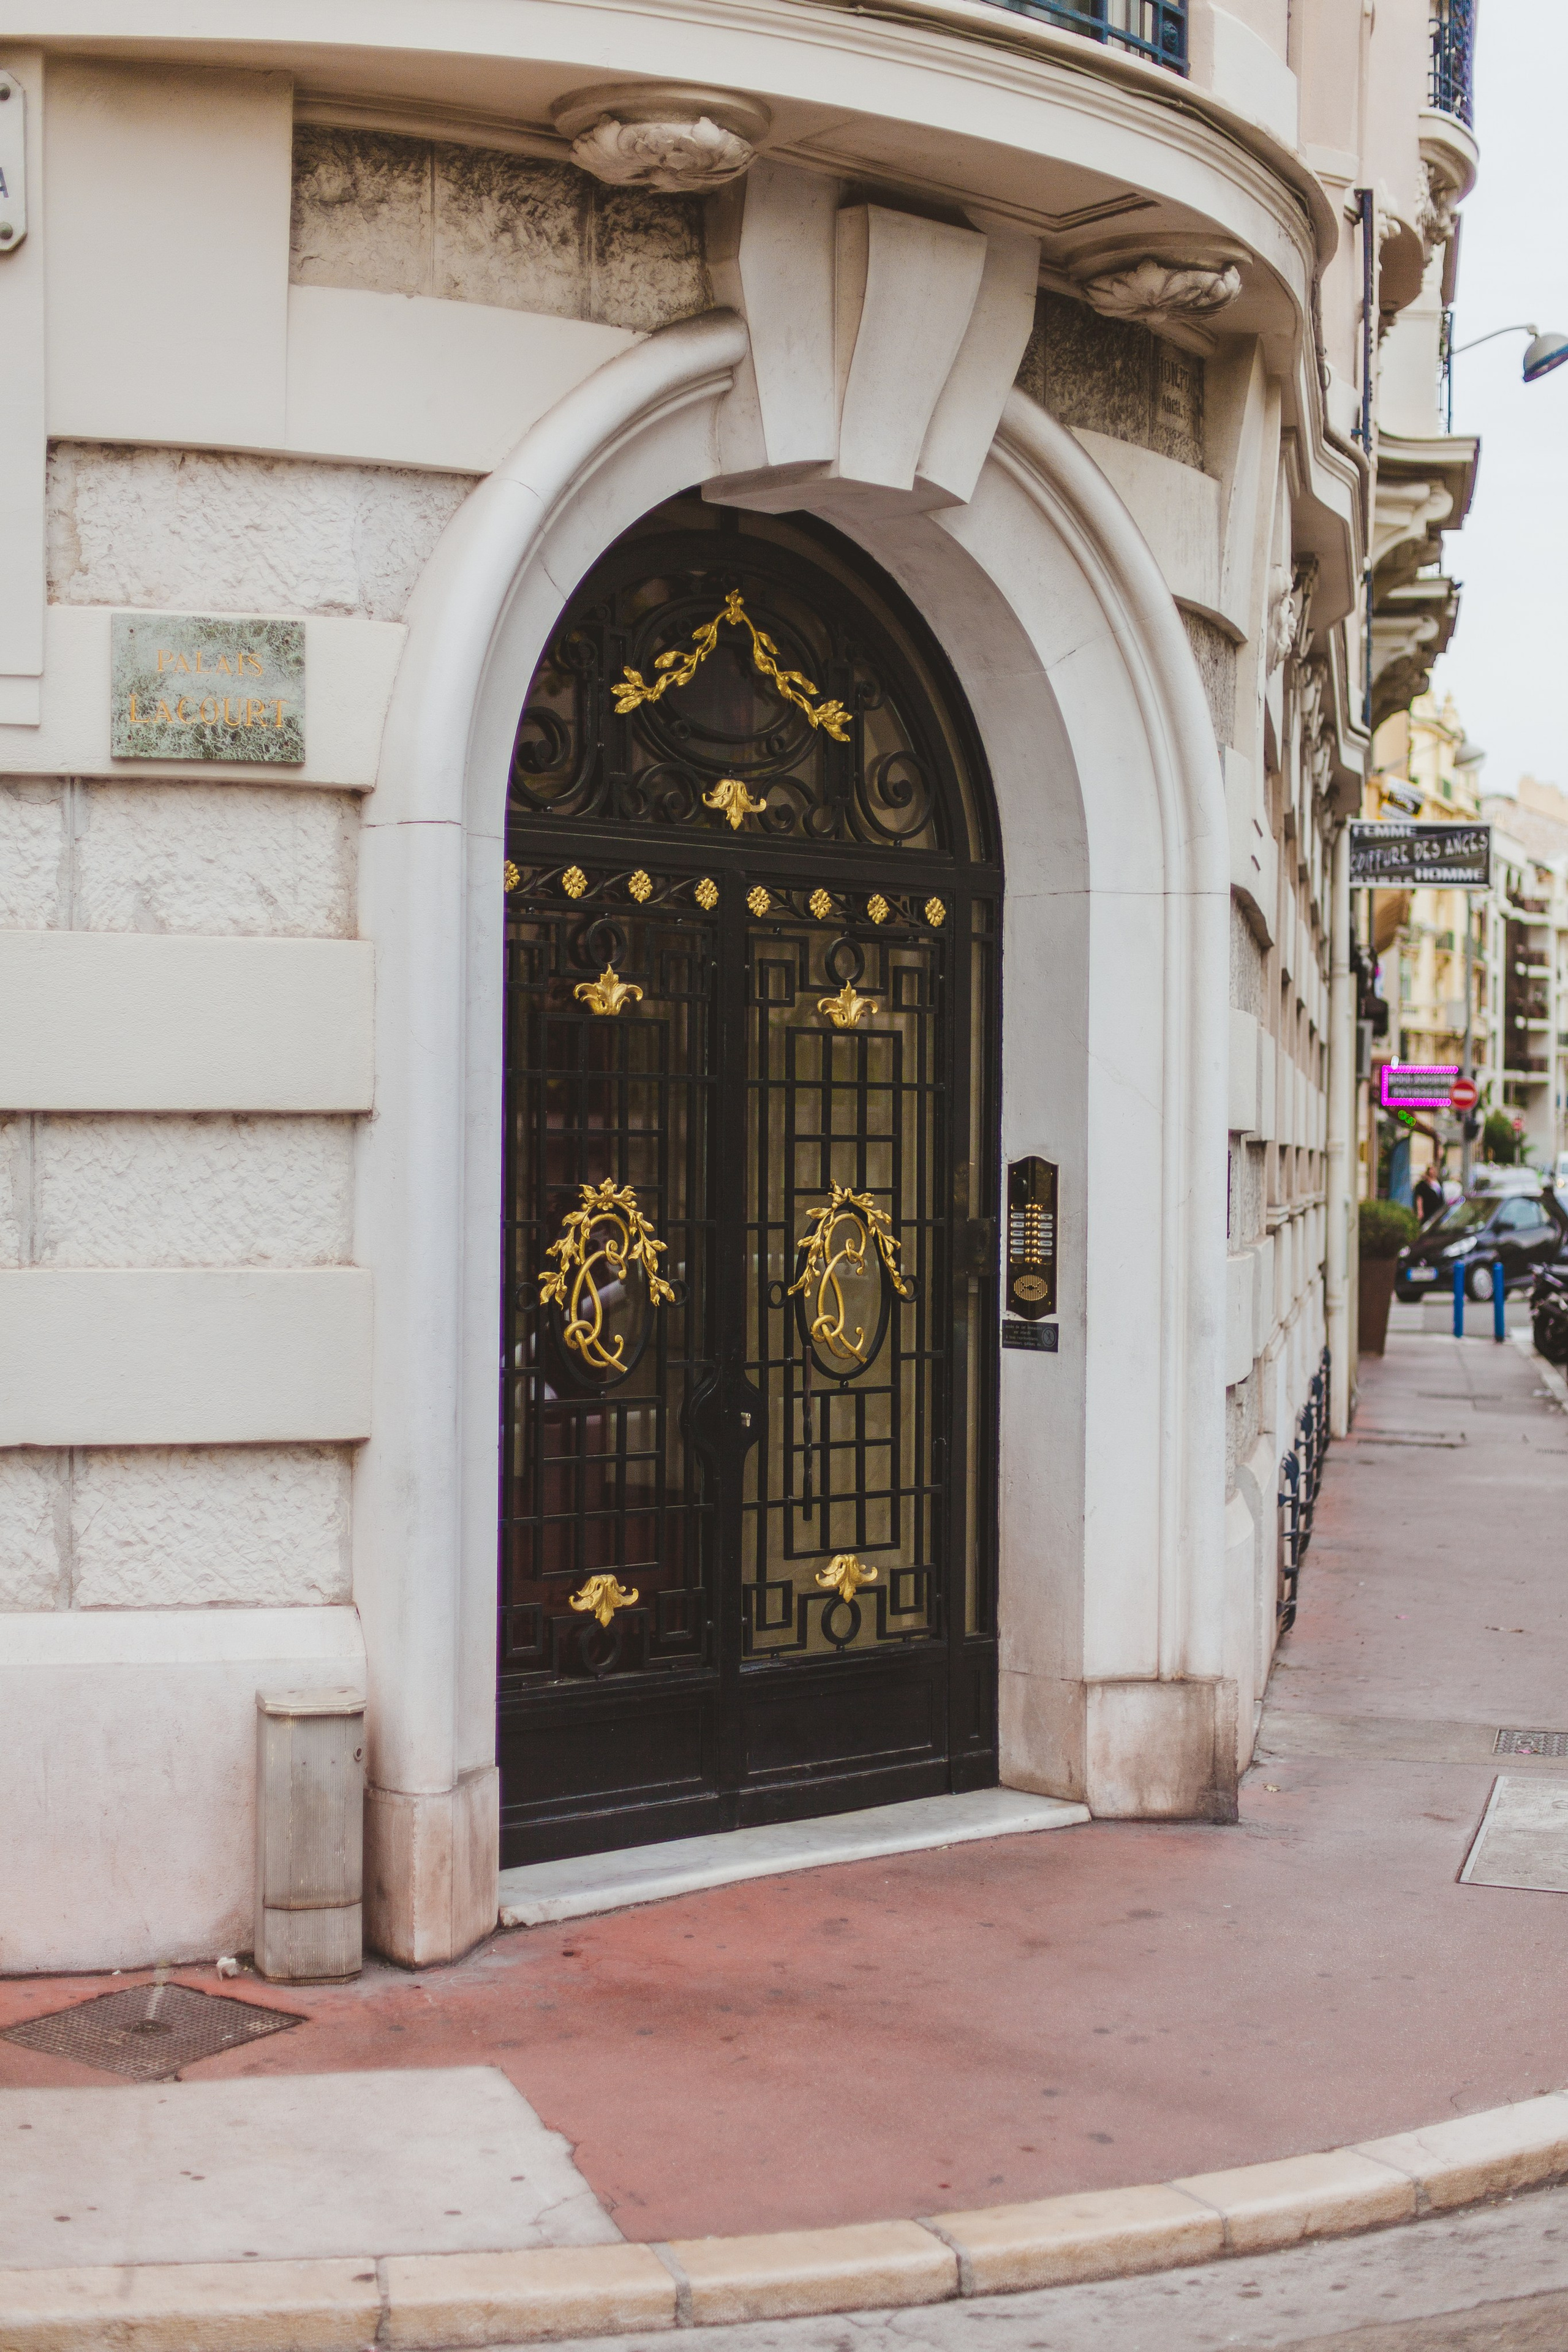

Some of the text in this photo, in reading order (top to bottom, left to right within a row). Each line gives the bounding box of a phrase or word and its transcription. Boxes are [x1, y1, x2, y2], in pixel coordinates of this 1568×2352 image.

[157, 649, 263, 677] PALAIS
[129, 693, 290, 728] LACOURT
[1352, 825, 1417, 838] FEMME
[1351, 830, 1488, 874] COIFFURE DES ANGES
[1414, 867, 1485, 882] HOMME
